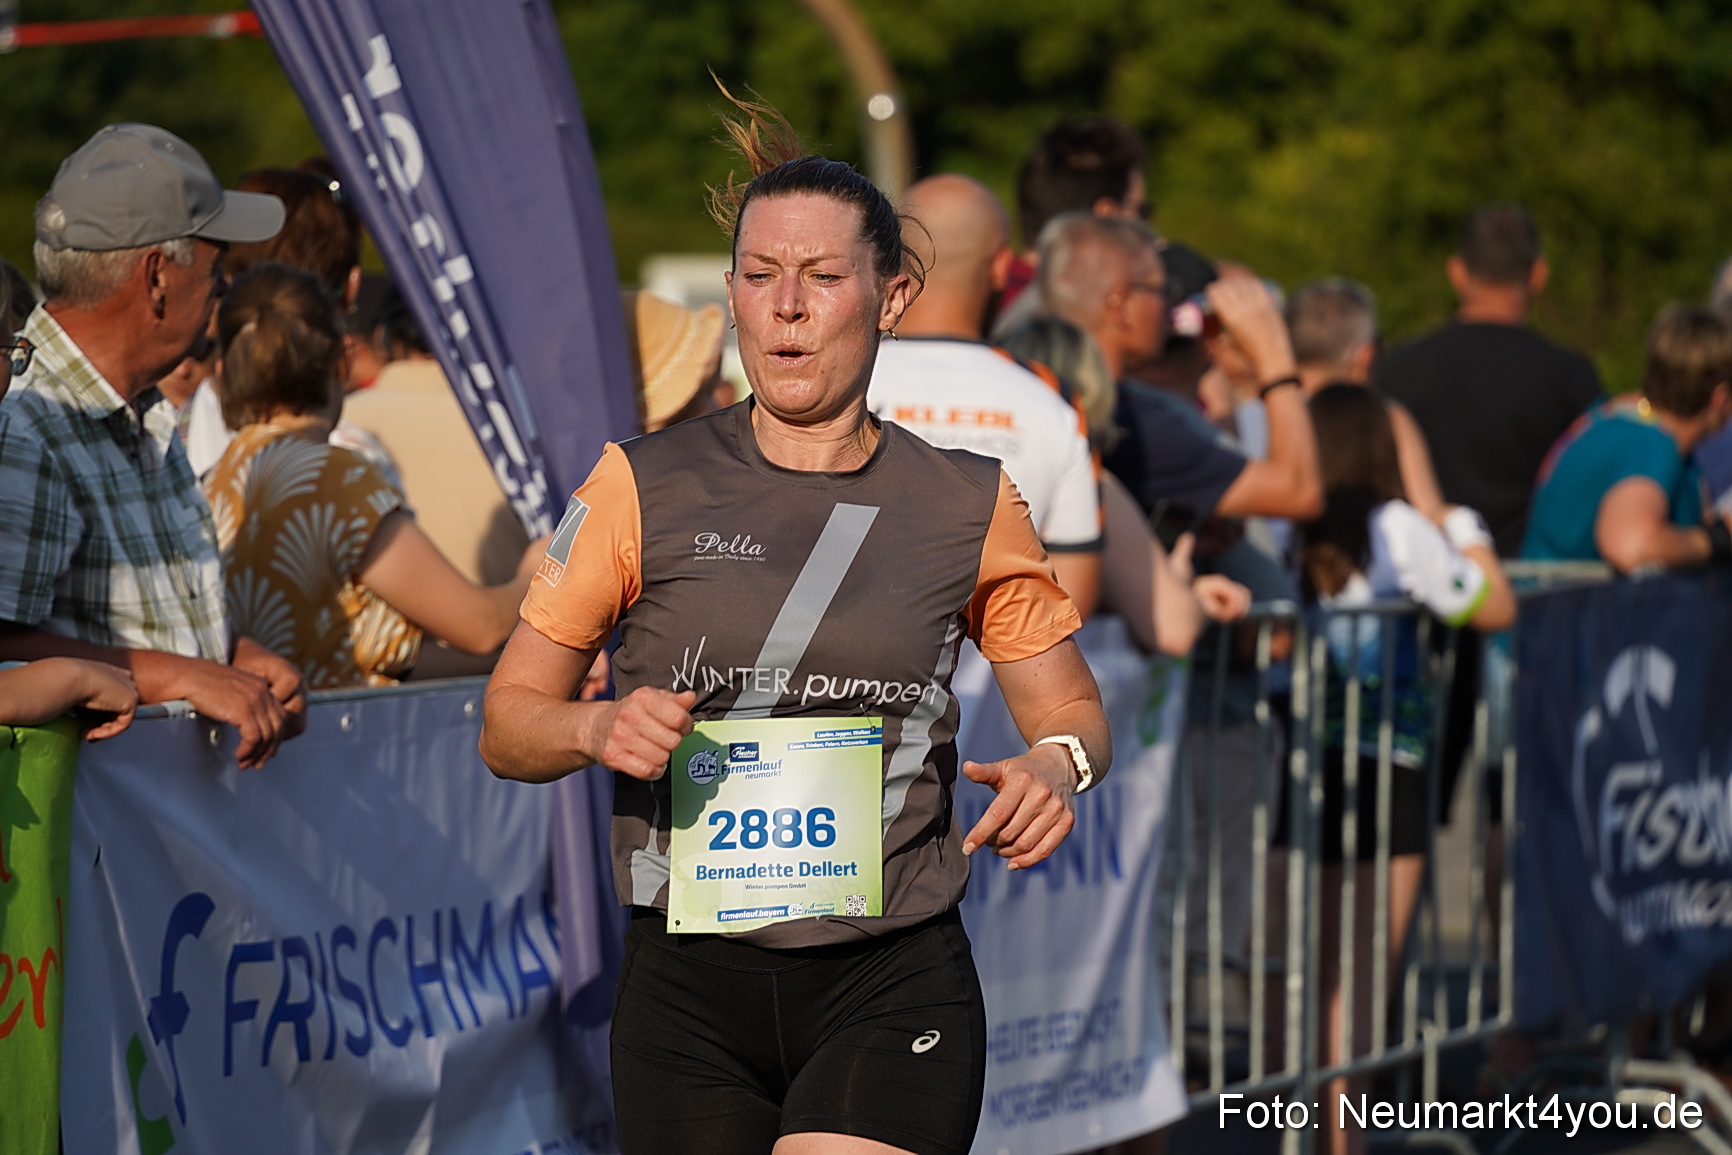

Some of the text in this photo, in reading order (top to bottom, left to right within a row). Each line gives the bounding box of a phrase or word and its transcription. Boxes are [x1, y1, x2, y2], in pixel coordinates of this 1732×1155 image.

[694, 531, 768, 556] Pella
[721, 759, 783, 775] Firmenlauf
[745, 770, 783, 780] neumarkt
[708, 807, 836, 851] 2886
[696, 861, 858, 881] Bernadette Dellert
[720, 908, 785, 921] firmenlauf.bayern
